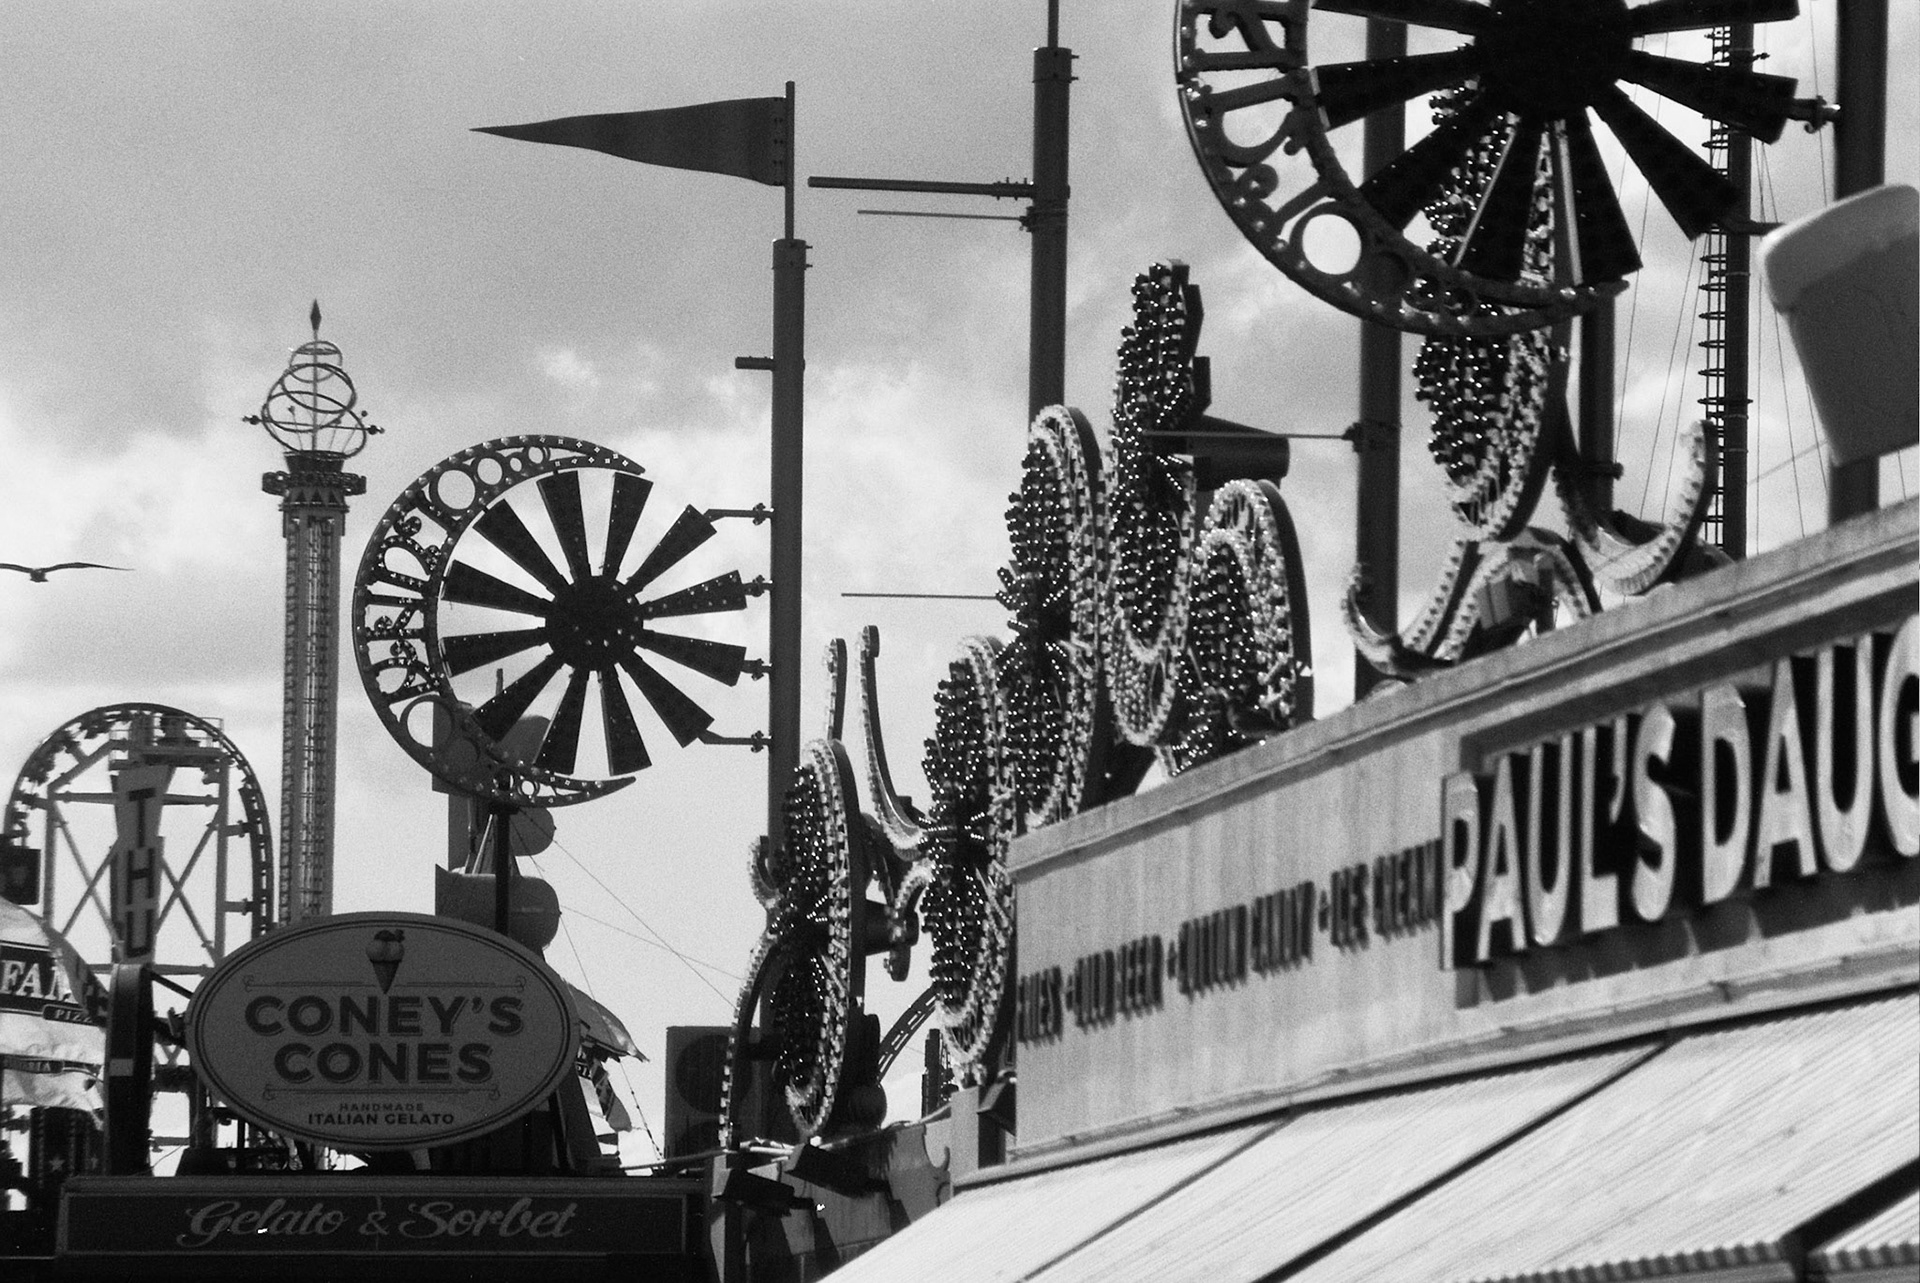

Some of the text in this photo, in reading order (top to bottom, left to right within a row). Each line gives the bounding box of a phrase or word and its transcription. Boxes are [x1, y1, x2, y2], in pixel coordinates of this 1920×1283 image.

[1442, 702, 1676, 970] PAUL'S
[245, 995, 524, 1036] CONEY'S
[274, 1043, 493, 1084] CONES
[308, 1113, 455, 1125] ITALIAN GELATO
[339, 1103, 424, 1112] HANDMADE
[176, 1198, 577, 1248] Gelato & Sorbet
